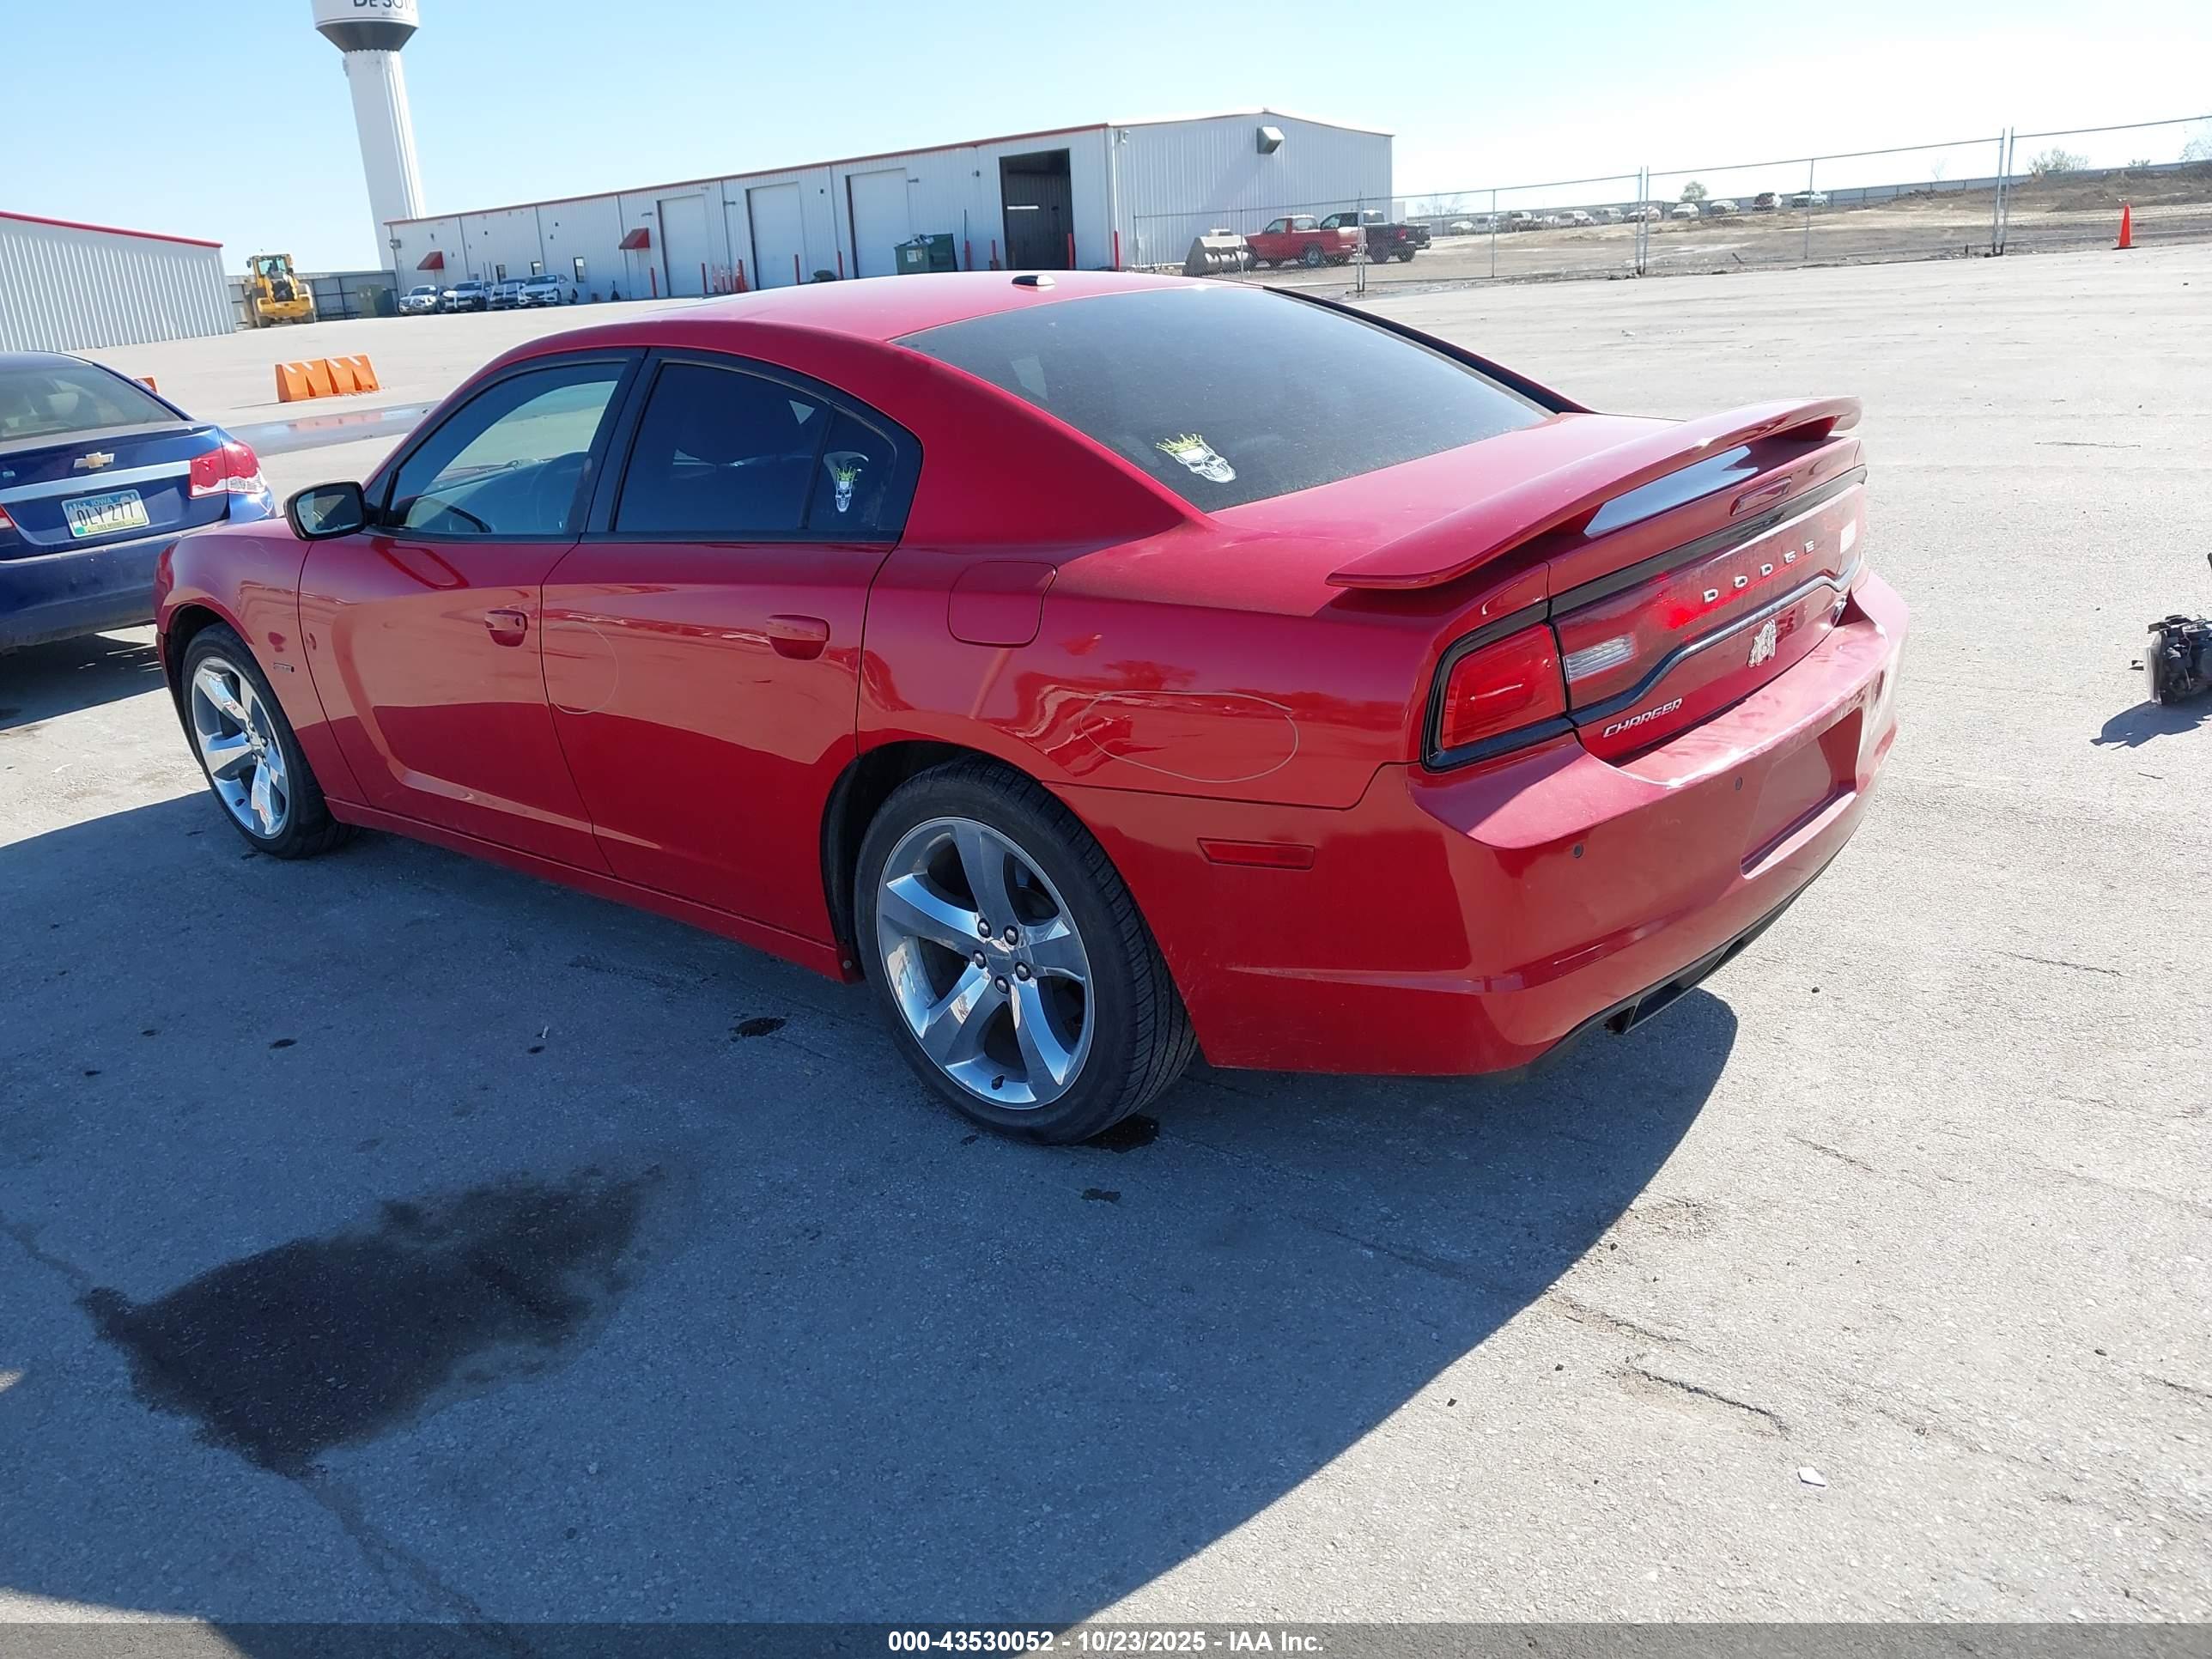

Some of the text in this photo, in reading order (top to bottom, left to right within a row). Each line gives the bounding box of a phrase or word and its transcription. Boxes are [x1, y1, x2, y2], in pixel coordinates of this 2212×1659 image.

[91, 497, 113, 506] IOWA
[107, 501, 134, 521] 277
[1703, 540, 1814, 603] DODGE
[1602, 697, 1683, 738] CHARGER
